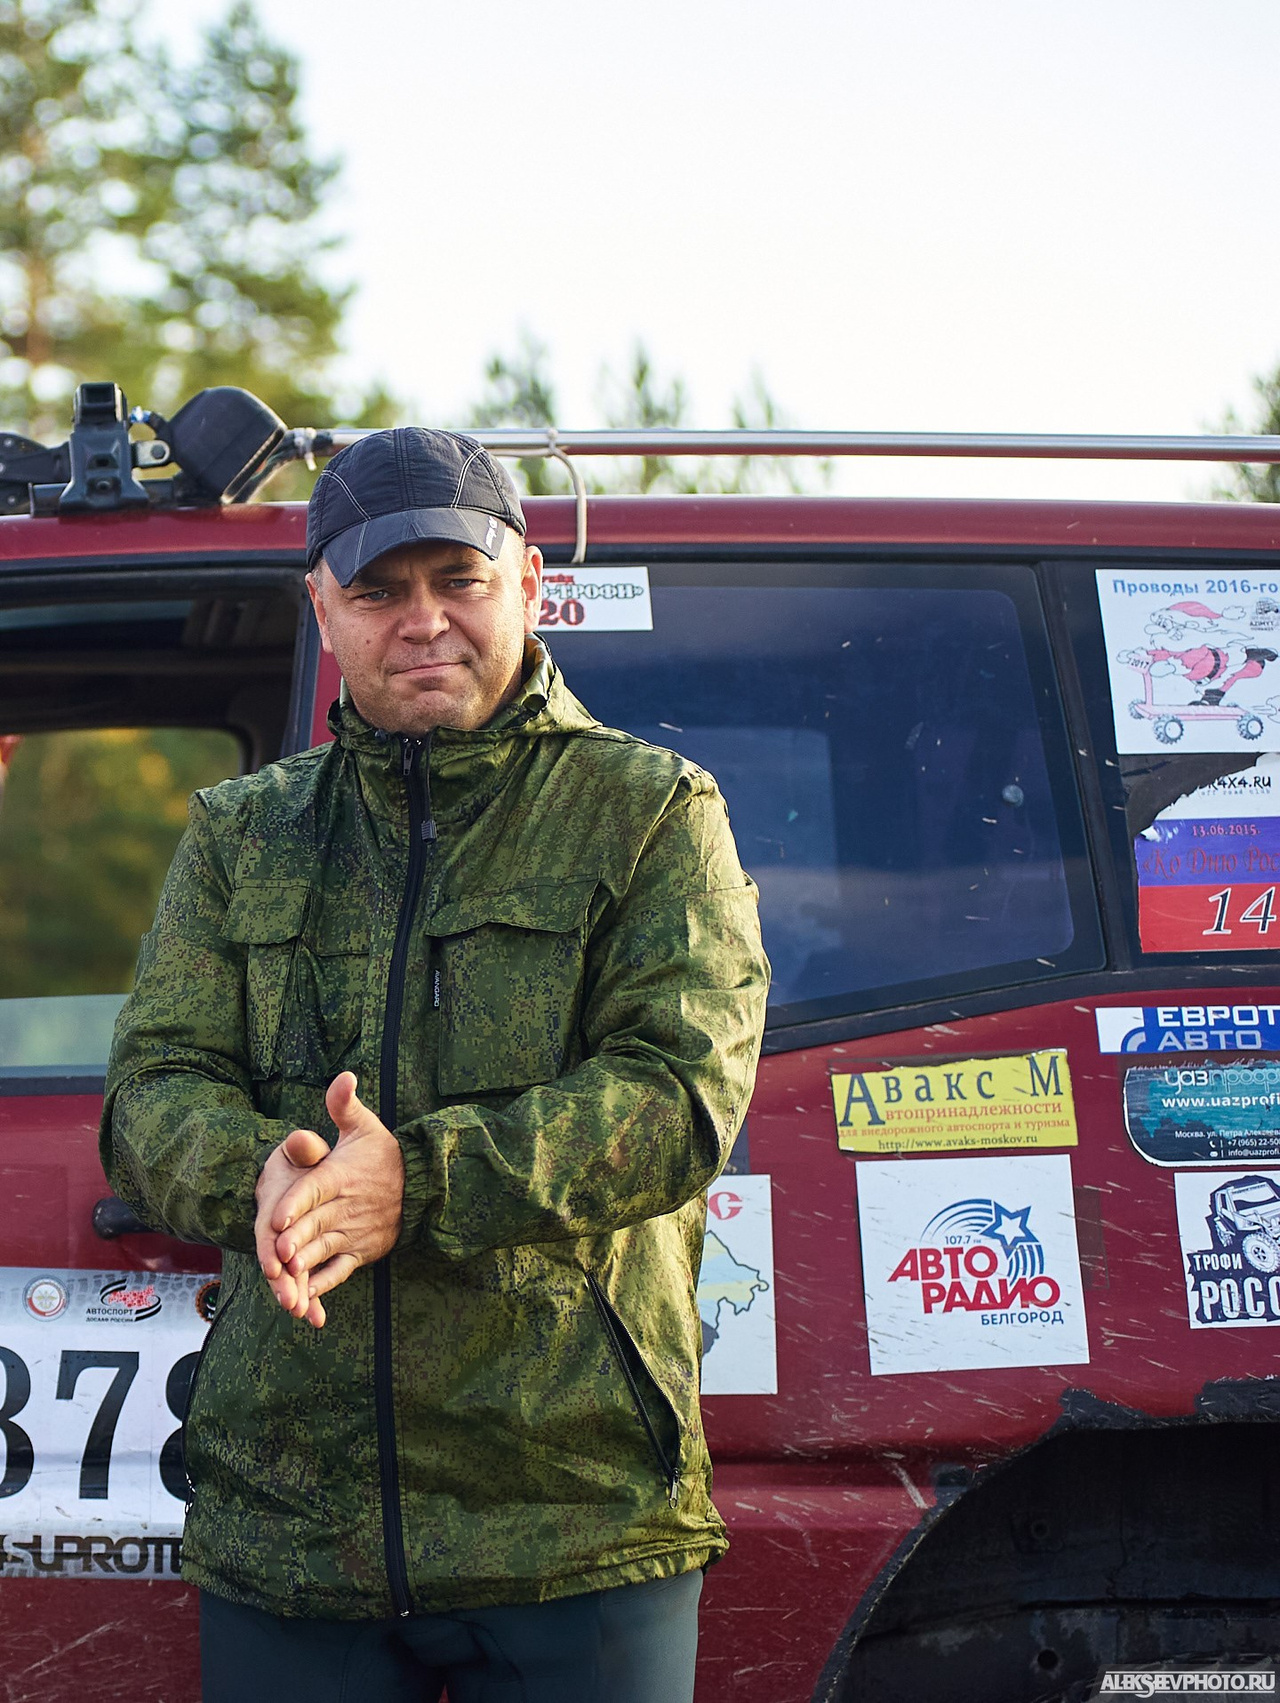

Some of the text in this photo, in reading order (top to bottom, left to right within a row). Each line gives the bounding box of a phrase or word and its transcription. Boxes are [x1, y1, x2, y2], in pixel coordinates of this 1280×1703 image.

[1113, 579, 1279, 596] Проводы 2016-го
[1187, 846, 1238, 875] Дню
[1202, 886, 1277, 936] 14
[1157, 1030, 1263, 1051] АВТО
[1025, 1055, 1064, 1097] М
[1026, 1119, 1070, 1131] туризма
[944, 1235, 971, 1246] 107.7
[887, 1245, 999, 1283] АВТО
[1192, 1252, 1243, 1272] ТРОФИ
[921, 1275, 1061, 1315] РАДИО
[85, 1308, 134, 1316] АВТОСПОРТ
[981, 1310, 1064, 1326] БЕЛГОРОД
